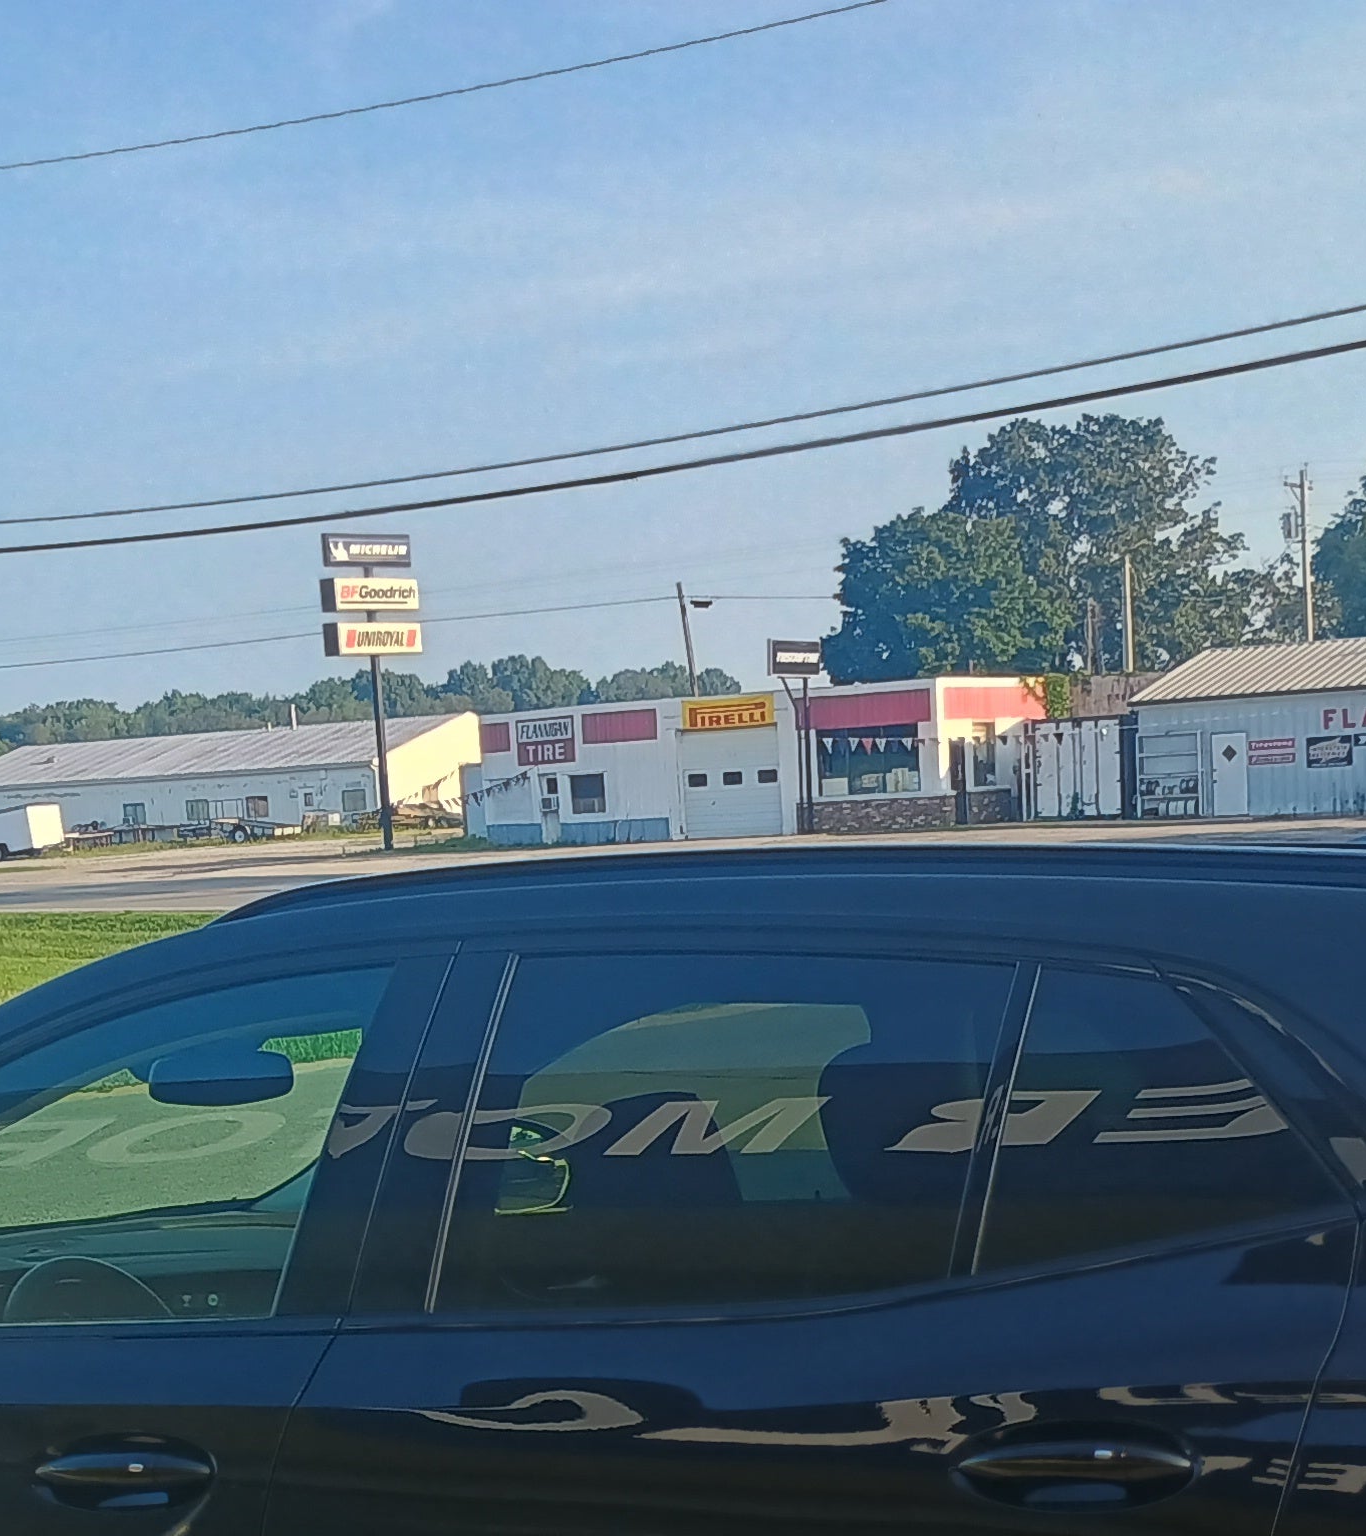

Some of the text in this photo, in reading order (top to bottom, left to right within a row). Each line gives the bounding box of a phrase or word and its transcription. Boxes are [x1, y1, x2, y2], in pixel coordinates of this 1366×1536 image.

[348, 544, 408, 556] MICHELIN
[340, 585, 416, 599] BFGoodrich
[357, 631, 405, 647] UNIROYAL
[688, 701, 766, 728] PIRELLI
[526, 743, 565, 762] TIRE
